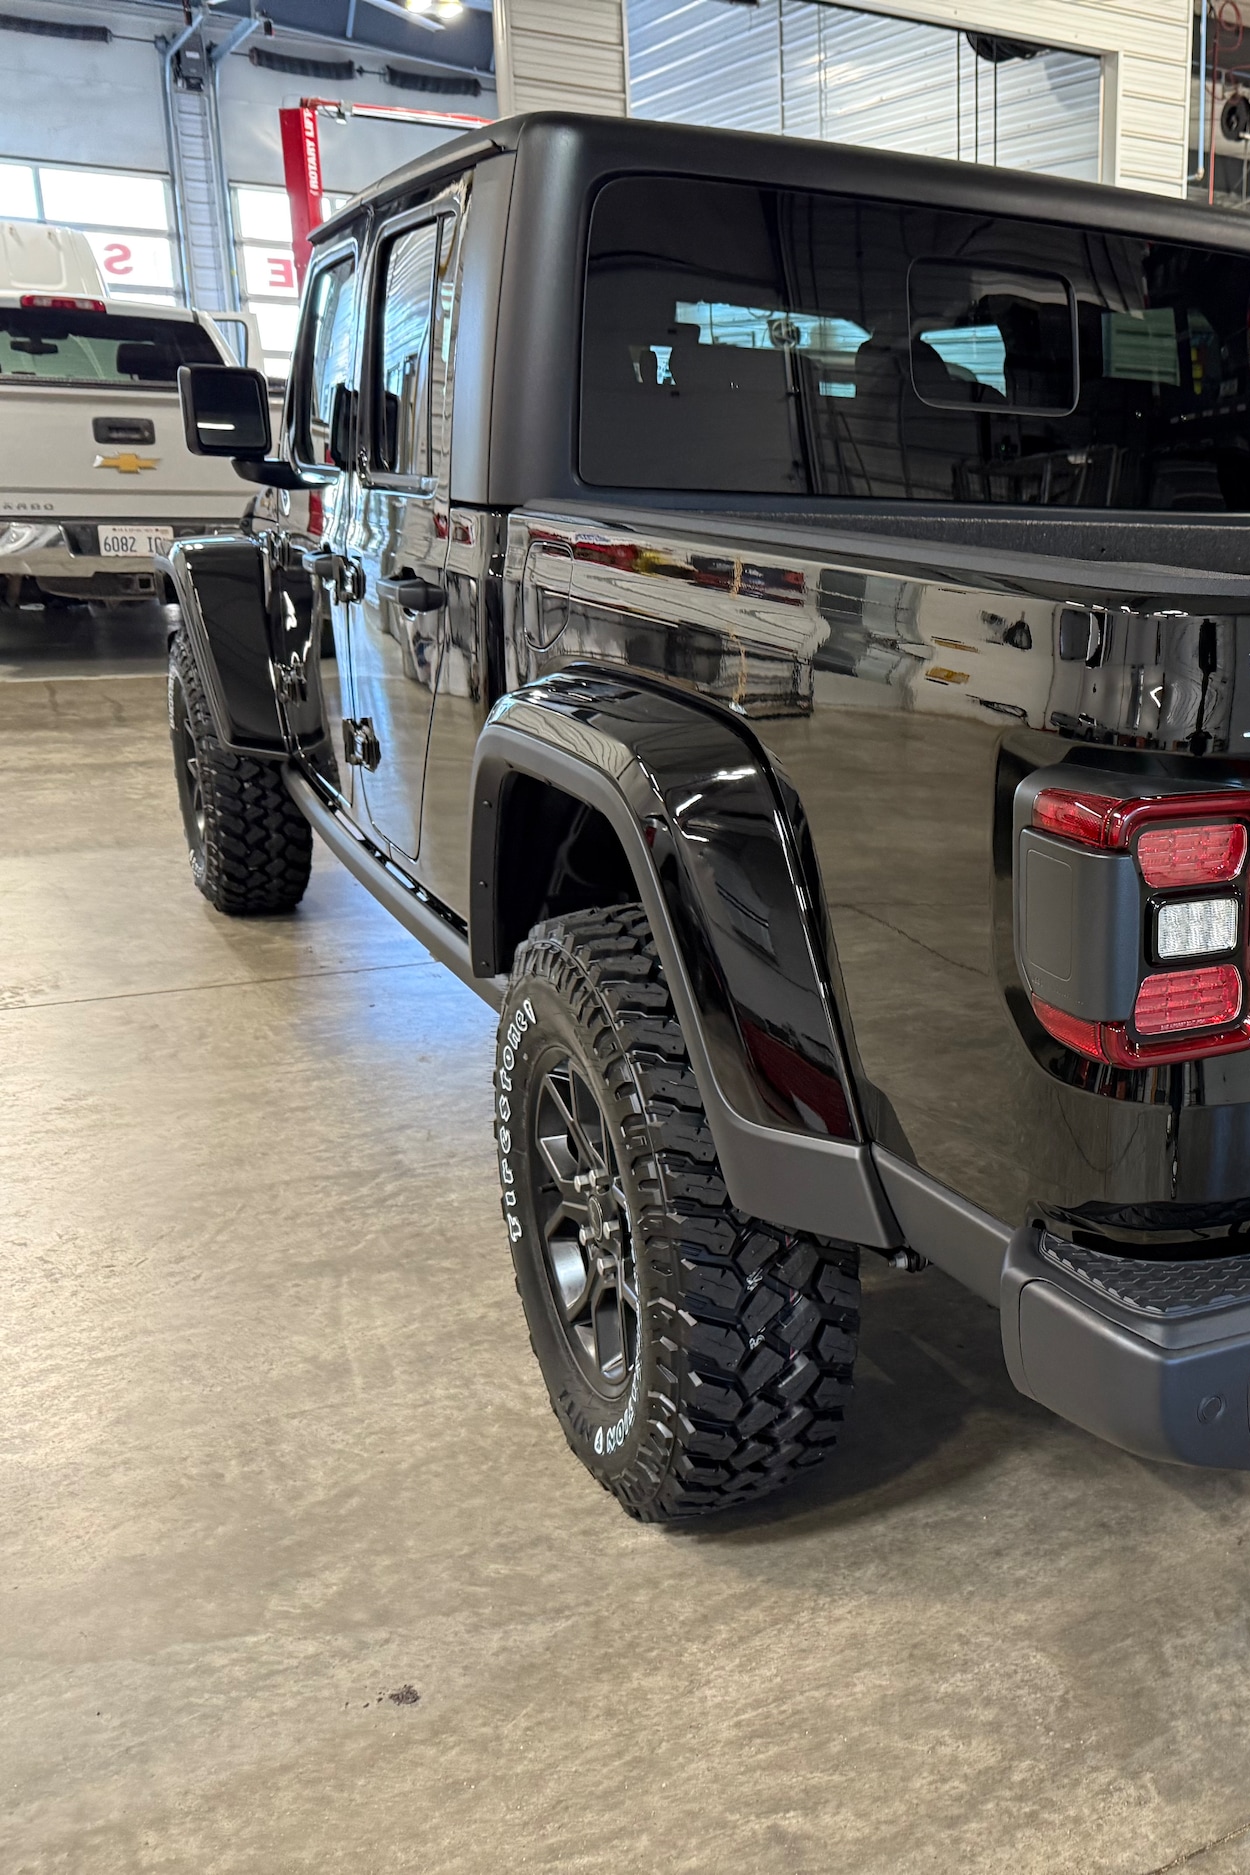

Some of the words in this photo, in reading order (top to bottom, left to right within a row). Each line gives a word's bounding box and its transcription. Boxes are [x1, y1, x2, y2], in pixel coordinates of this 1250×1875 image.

[303, 107, 315, 139] LIFT
[305, 138, 320, 190] ROTARY
[103, 536, 137, 553] 6082
[500, 1010, 528, 1242] Firestone
